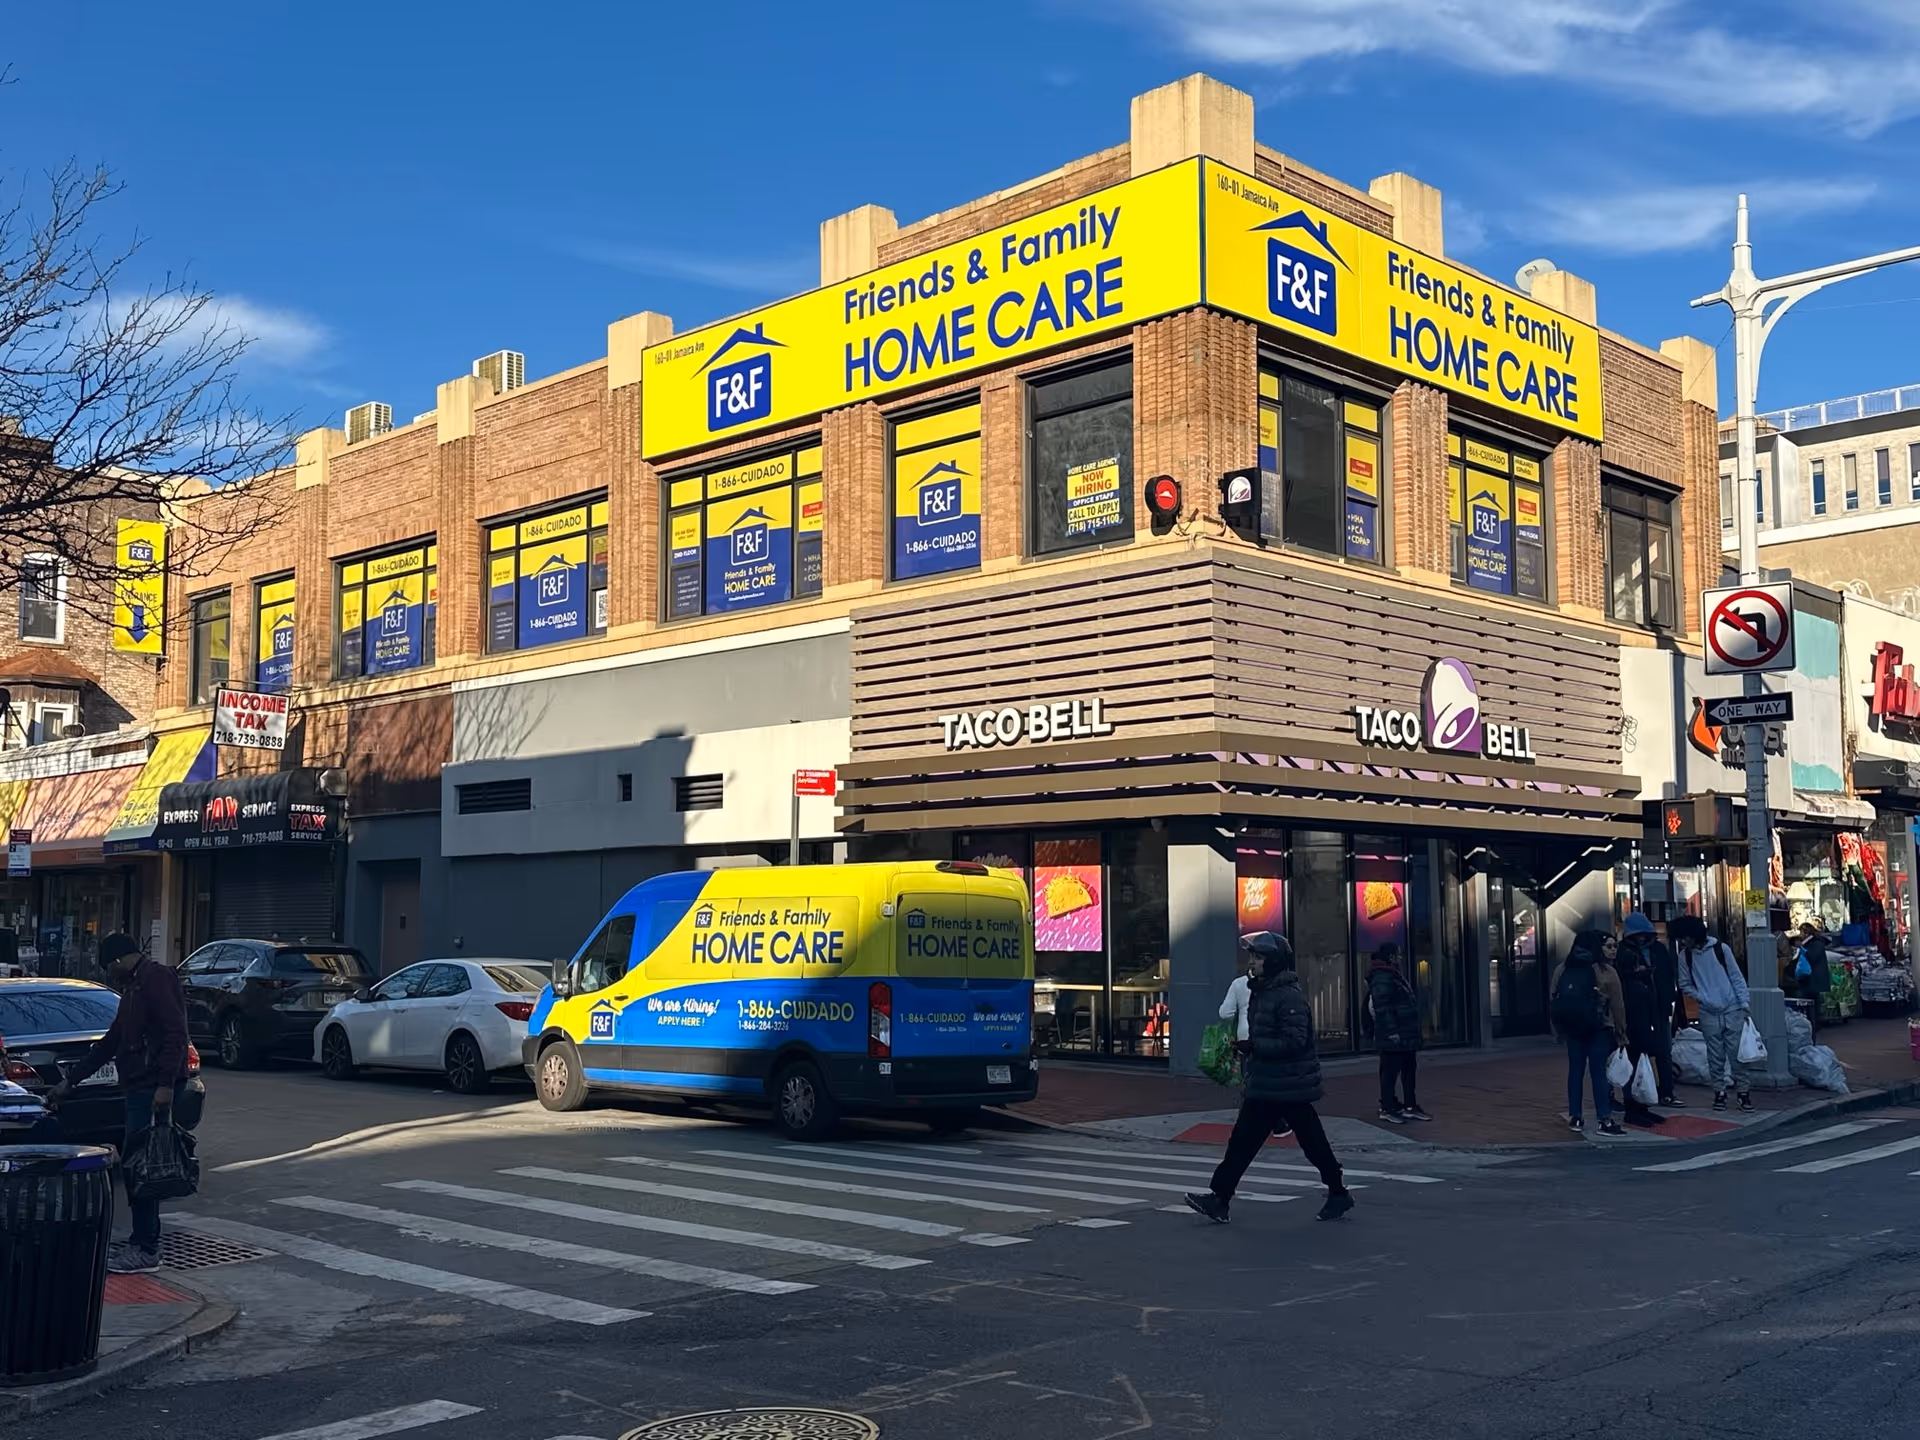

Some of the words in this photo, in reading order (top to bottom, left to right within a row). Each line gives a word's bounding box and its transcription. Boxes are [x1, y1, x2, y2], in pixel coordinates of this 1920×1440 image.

[1216, 173, 1240, 196] 160-01
[1241, 184, 1267, 208] Jamaica
[1267, 195, 1280, 213] Ave
[845, 261, 954, 324] Friends
[966, 247, 988, 284] &
[1001, 205, 1122, 273] Family
[1276, 254, 1329, 316] F&F
[1388, 249, 1474, 319] Friends
[1481, 294, 1498, 329] &
[1504, 301, 1575, 364] Family
[845, 305, 975, 393] HOME
[986, 256, 1124, 348] CARE
[654, 349, 672, 366] 160-01
[673, 345, 695, 360] Jamaica
[695, 341, 706, 355] Ave
[1389, 305, 1490, 393] HOME
[1496, 350, 1579, 423] CARE
[714, 366, 763, 415] F&F
[1082, 463, 1097, 472] CARE
[1097, 457, 1118, 468] AGENCY
[714, 462, 785, 490] 1-866-CUIDADO
[1082, 470, 1105, 484] NOW
[1074, 479, 1113, 497] HIRING
[924, 485, 957, 516] F&F
[1072, 496, 1095, 507] OFFICE
[1095, 492, 1115, 502] STAFF
[1068, 508, 1086, 521] CALL
[1087, 505, 1096, 517] TO
[1097, 500, 1119, 513] APPLY
[525, 514, 582, 538] 1-866-CUIDADO
[1351, 525, 1364, 536] PCA
[1475, 509, 1497, 535] F&F
[736, 529, 764, 557] F&F
[905, 529, 977, 554] 1-866-CUIDADO
[130, 547, 151, 560] F&F
[372, 555, 419, 575] 1-866-CUIDADO
[724, 568, 747, 581] Friends
[748, 566, 754, 575] &
[754, 563, 776, 576] Family
[1467, 556, 1487, 571] HOME
[1488, 561, 1508, 575] CARE
[542, 574, 565, 598] F&F
[724, 578, 750, 594] HOME
[751, 573, 776, 589] CARE
[384, 608, 404, 630] F&F
[529, 610, 578, 629] 1-866-CUIDADO
[274, 631, 292, 651] F&F
[375, 648, 393, 660] HOME
[393, 644, 410, 657] CARE
[219, 690, 287, 714] INCOME
[1718, 705, 1744, 718] ONE
[1754, 702, 1782, 715] WAY
[234, 711, 269, 732] TAX
[937, 707, 1024, 749] TACO
[1028, 697, 1116, 744] BELL
[215, 731, 284, 748] 718-739-0888
[1351, 705, 1420, 751] TACO
[1484, 721, 1537, 762] BELL
[163, 809, 199, 824] EXPRESS
[202, 796, 239, 833] TAX
[242, 801, 277, 818] SERVICE
[290, 804, 325, 813] EXPRESS
[288, 813, 327, 832] TAX
[184, 838, 200, 848] OPEN
[201, 837, 213, 847] ALL
[214, 836, 230, 846] YEAR
[290, 831, 323, 841] SERVICE
[696, 913, 711, 926] F&F
[719, 909, 766, 927] Friends
[769, 909, 779, 926] &
[783, 908, 832, 929] Family
[909, 915, 925, 927] F&F
[931, 916, 973, 931] Friends
[975, 919, 984, 931] &
[986, 919, 1020, 936] Family
[691, 931, 765, 964] HOME
[769, 930, 844, 964] CARE
[907, 934, 968, 959] HOME
[972, 936, 1020, 960] CARE
[647, 997, 665, 1013] We
[664, 1001, 682, 1013] are
[682, 997, 721, 1018] Hiring!
[737, 999, 855, 1022] 1-866-CUIDADO
[899, 1012, 967, 1024] 1-866-CUIDADO
[972, 1012, 987, 1022] We
[987, 1013, 999, 1022] are
[999, 1012, 1025, 1023] Hiring!
[592, 1014, 612, 1032] F&F
[657, 1016, 679, 1027] APPLY
[737, 1019, 790, 1032] 1-866-284-3236
